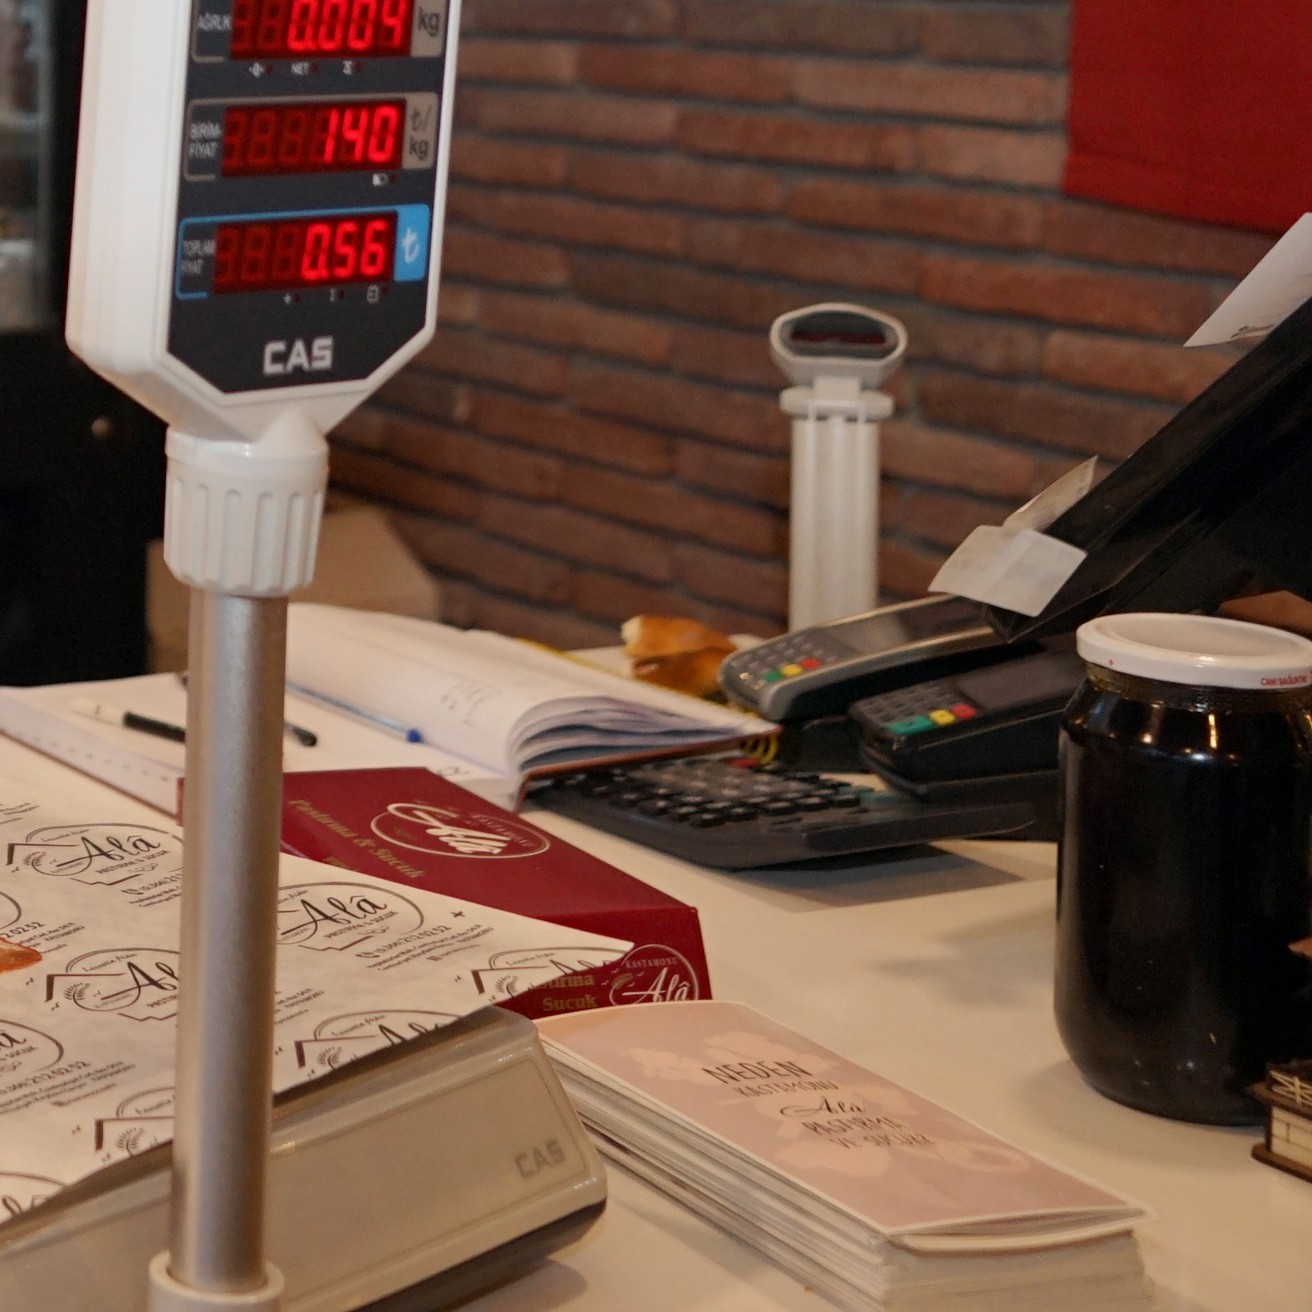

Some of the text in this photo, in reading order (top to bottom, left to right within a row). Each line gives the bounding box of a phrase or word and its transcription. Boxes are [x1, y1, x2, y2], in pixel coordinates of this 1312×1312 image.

[418, 8, 441, 37] kg
[291, 61, 310, 75] NET
[323, 105, 400, 165] 140
[409, 141, 429, 161] kg
[262, 335, 334, 376] CAS
[56, 834, 161, 868] Alâ
[280, 894, 387, 936] Alâ
[100, 961, 179, 1001] Al
[542, 993, 598, 1012] Sucuk
[701, 1060, 813, 1085] NEDEN
[731, 1079, 840, 1099] KASTAMONU
[514, 1138, 566, 1180] CAS
